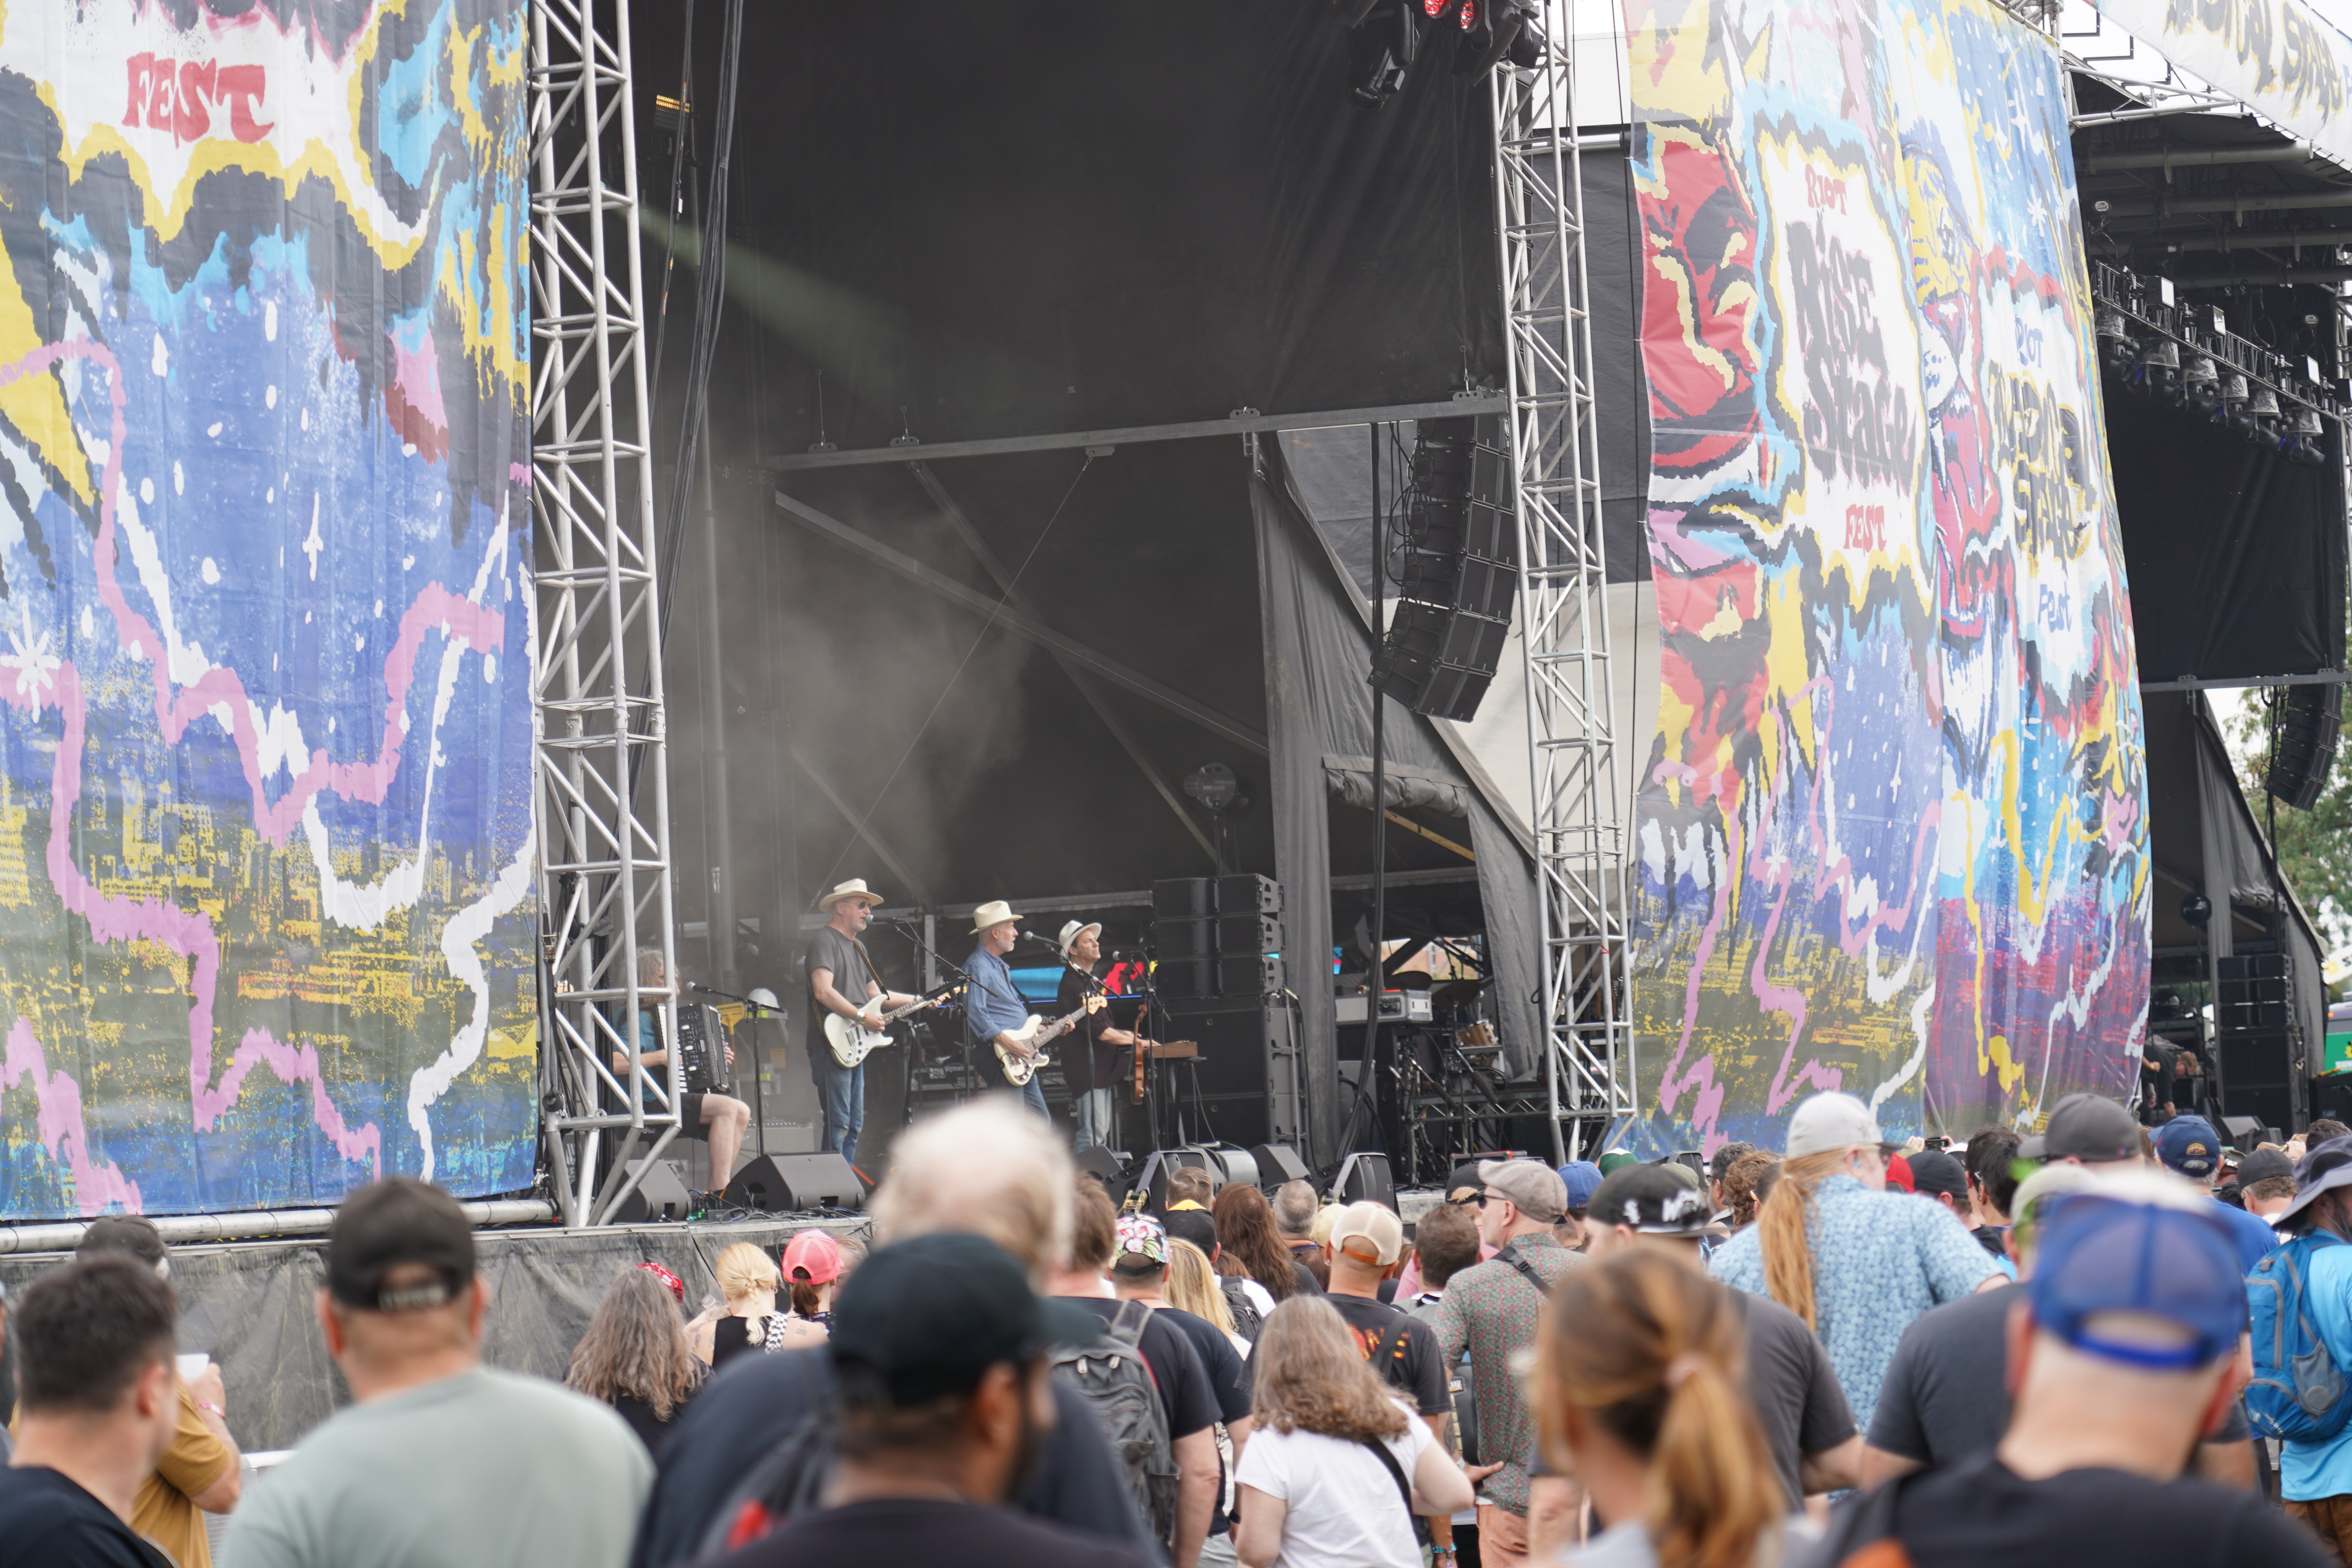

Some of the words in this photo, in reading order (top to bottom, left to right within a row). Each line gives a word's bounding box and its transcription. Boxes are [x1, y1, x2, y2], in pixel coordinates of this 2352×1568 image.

[122, 51, 274, 148] FEST
[1805, 163, 1847, 216] RIOT
[2015, 315, 2044, 369] RIOT
[1844, 503, 1887, 557] FEST
